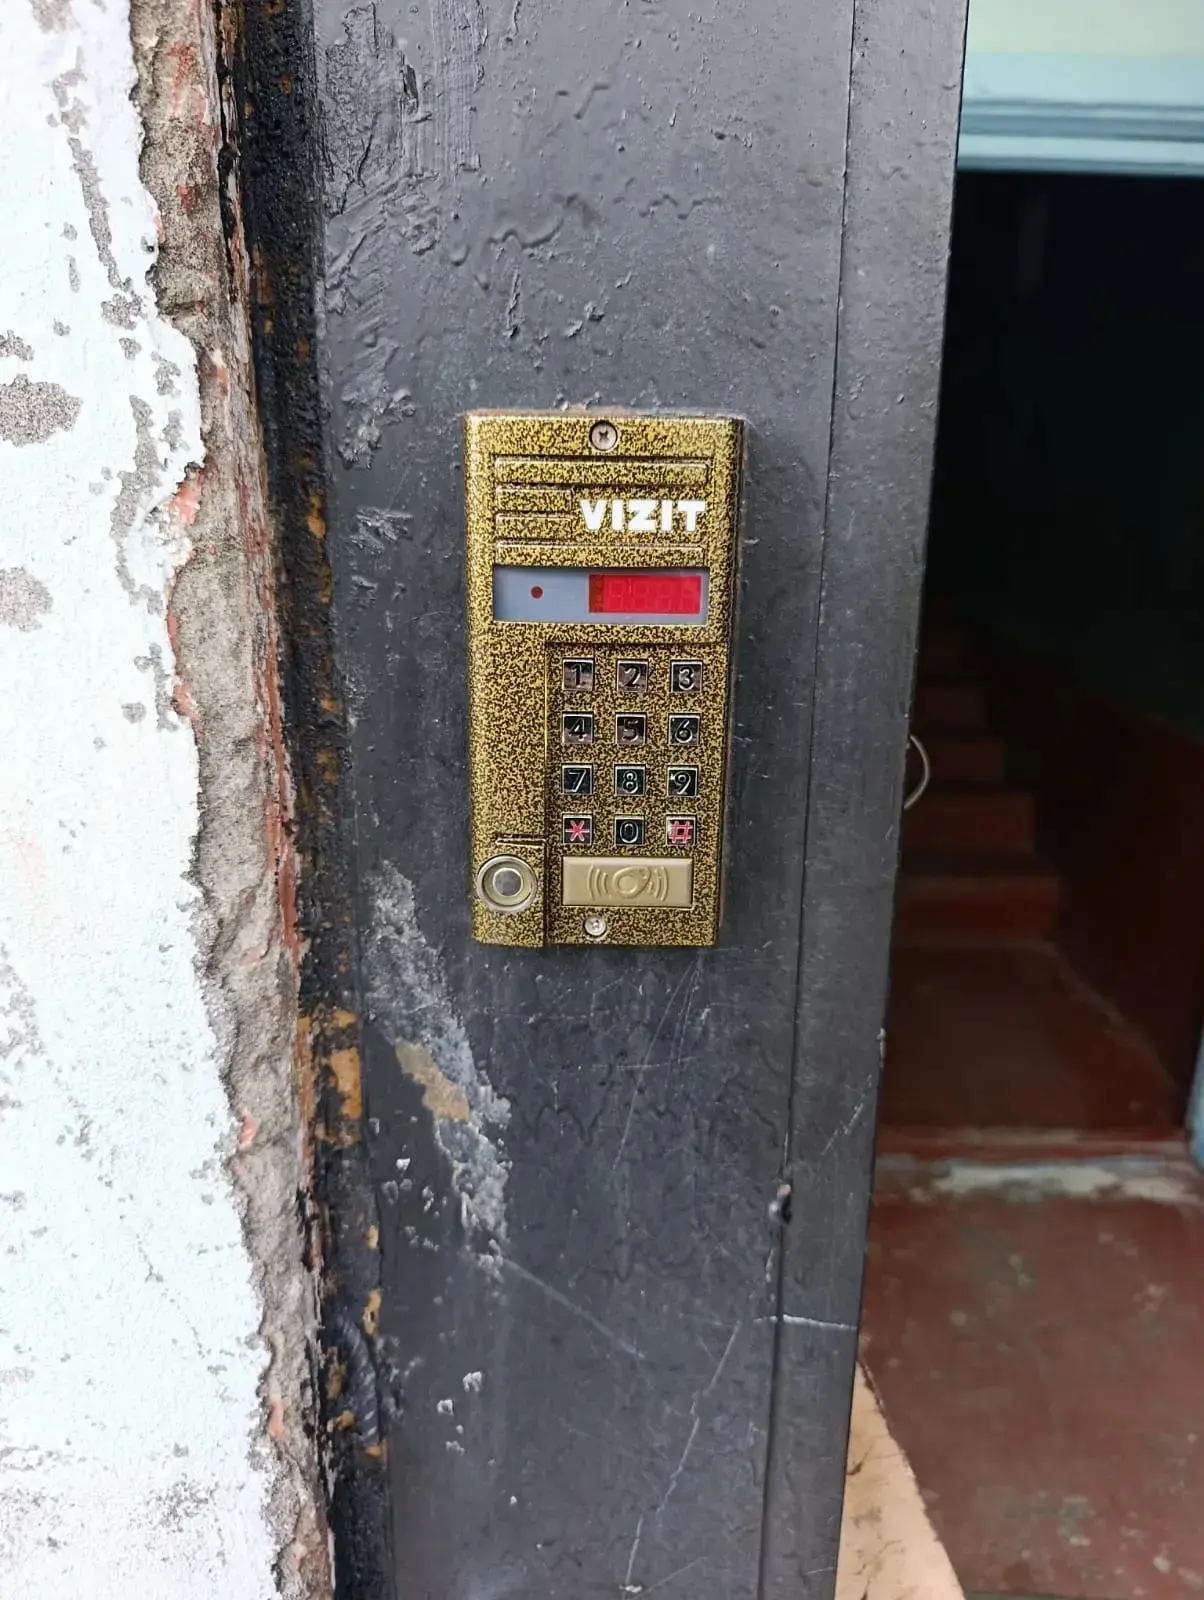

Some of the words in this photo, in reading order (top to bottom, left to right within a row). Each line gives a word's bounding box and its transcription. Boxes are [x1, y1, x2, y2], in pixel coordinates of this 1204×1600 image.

[579, 499, 705, 532] VIZIT
[570, 663, 583, 688] 1
[624, 665, 641, 689] 2
[678, 665, 695, 690] 3
[568, 718, 587, 742] 4
[622, 718, 639, 742] 5
[675, 718, 693, 743] 6
[568, 769, 587, 792] 7
[622, 769, 639, 794] 8
[674, 770, 692, 795] 9
[619, 820, 639, 843] 0
